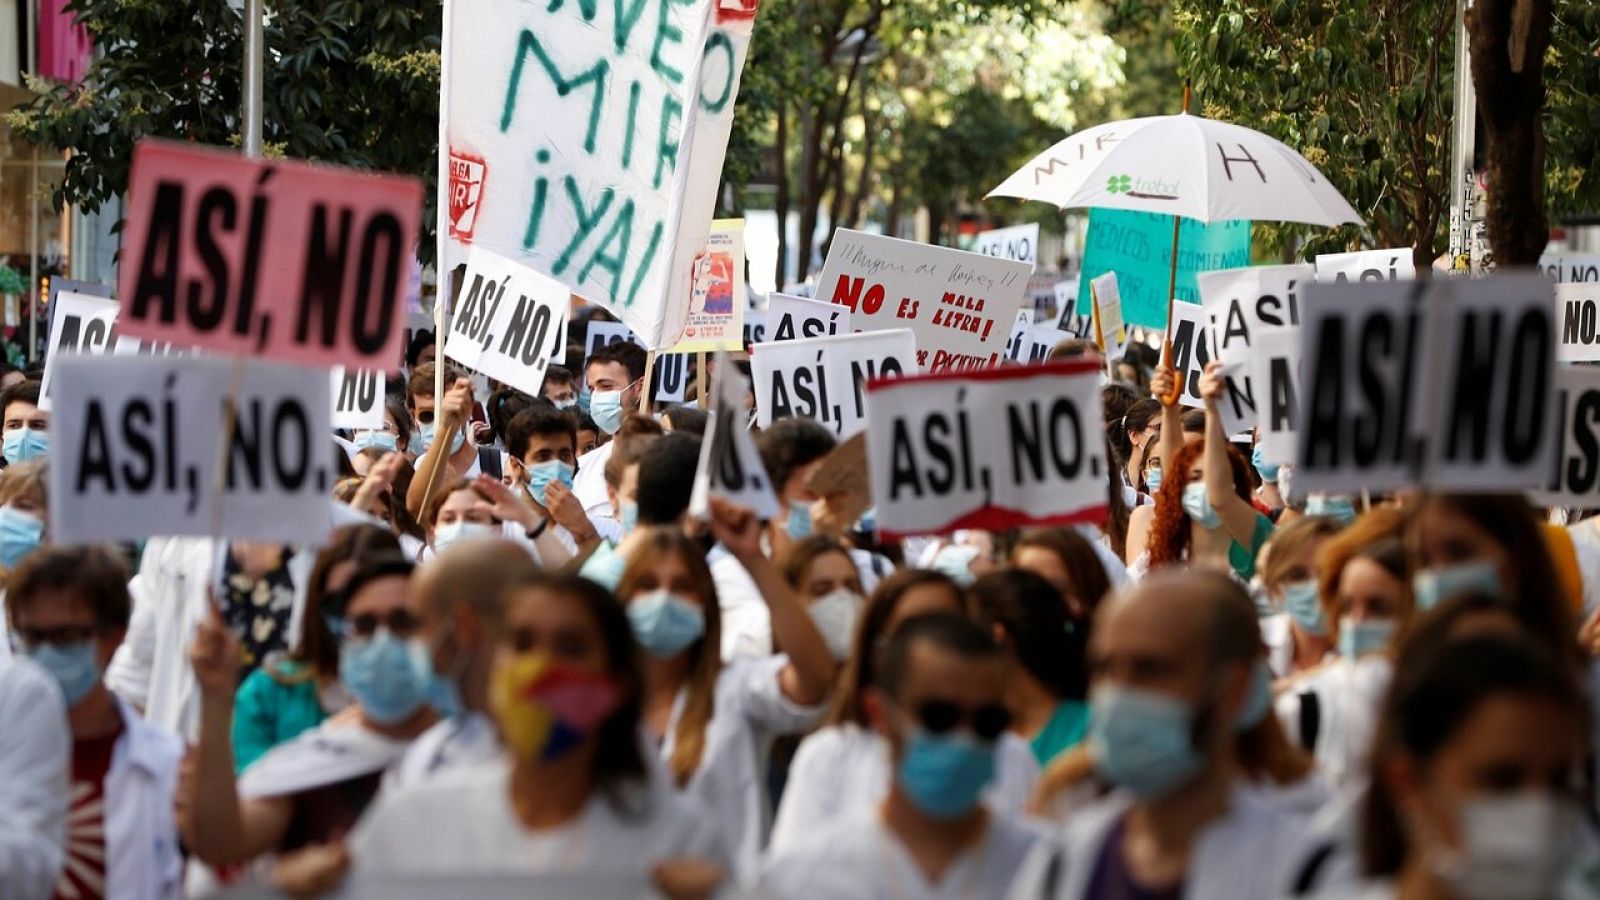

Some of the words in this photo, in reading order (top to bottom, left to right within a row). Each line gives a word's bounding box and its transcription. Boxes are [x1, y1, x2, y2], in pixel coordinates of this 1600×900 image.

[130, 166, 277, 354] ASÍ,
[294, 203, 405, 357] NO
[831, 273, 886, 316] NO
[896, 297, 920, 319] ES
[941, 290, 986, 313] MALA
[500, 294, 551, 372] NO.
[75, 374, 199, 513] ASÍ,
[224, 398, 327, 492] NO.
[889, 386, 993, 508] ASÍ,
[1007, 396, 1100, 485] NO.
